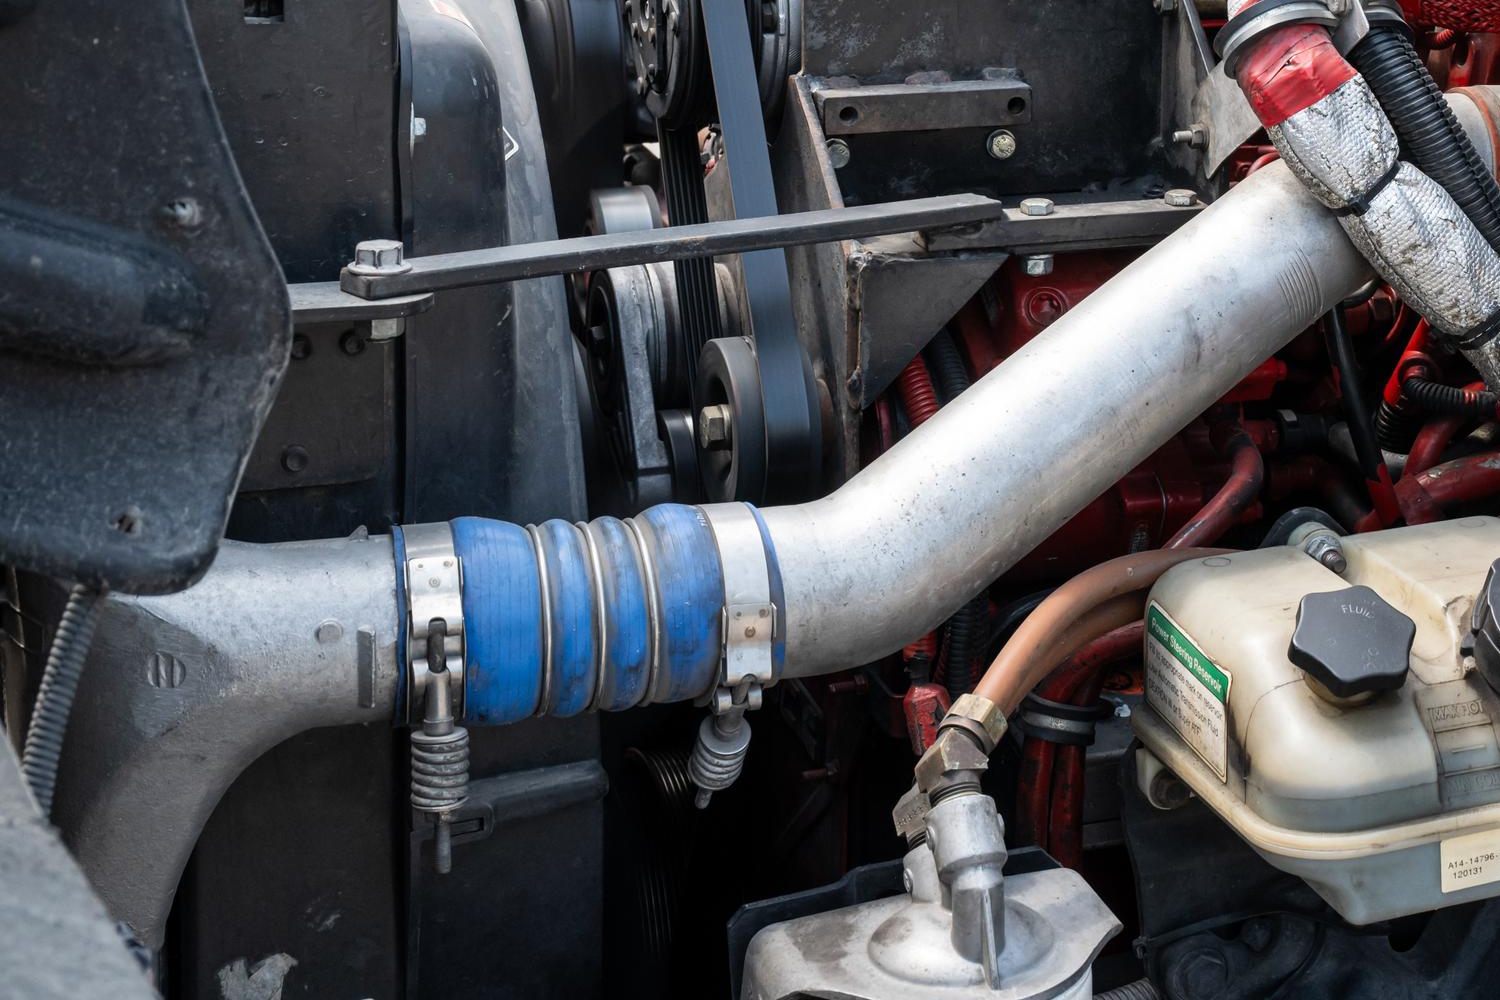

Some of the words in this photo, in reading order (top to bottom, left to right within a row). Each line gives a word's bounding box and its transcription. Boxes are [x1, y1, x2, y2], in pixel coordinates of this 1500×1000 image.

[1151, 617, 1170, 641] Power
[1170, 634, 1193, 669] Steering
[1193, 657, 1222, 693] Reservoir
[1453, 866, 1483, 879] 120131
